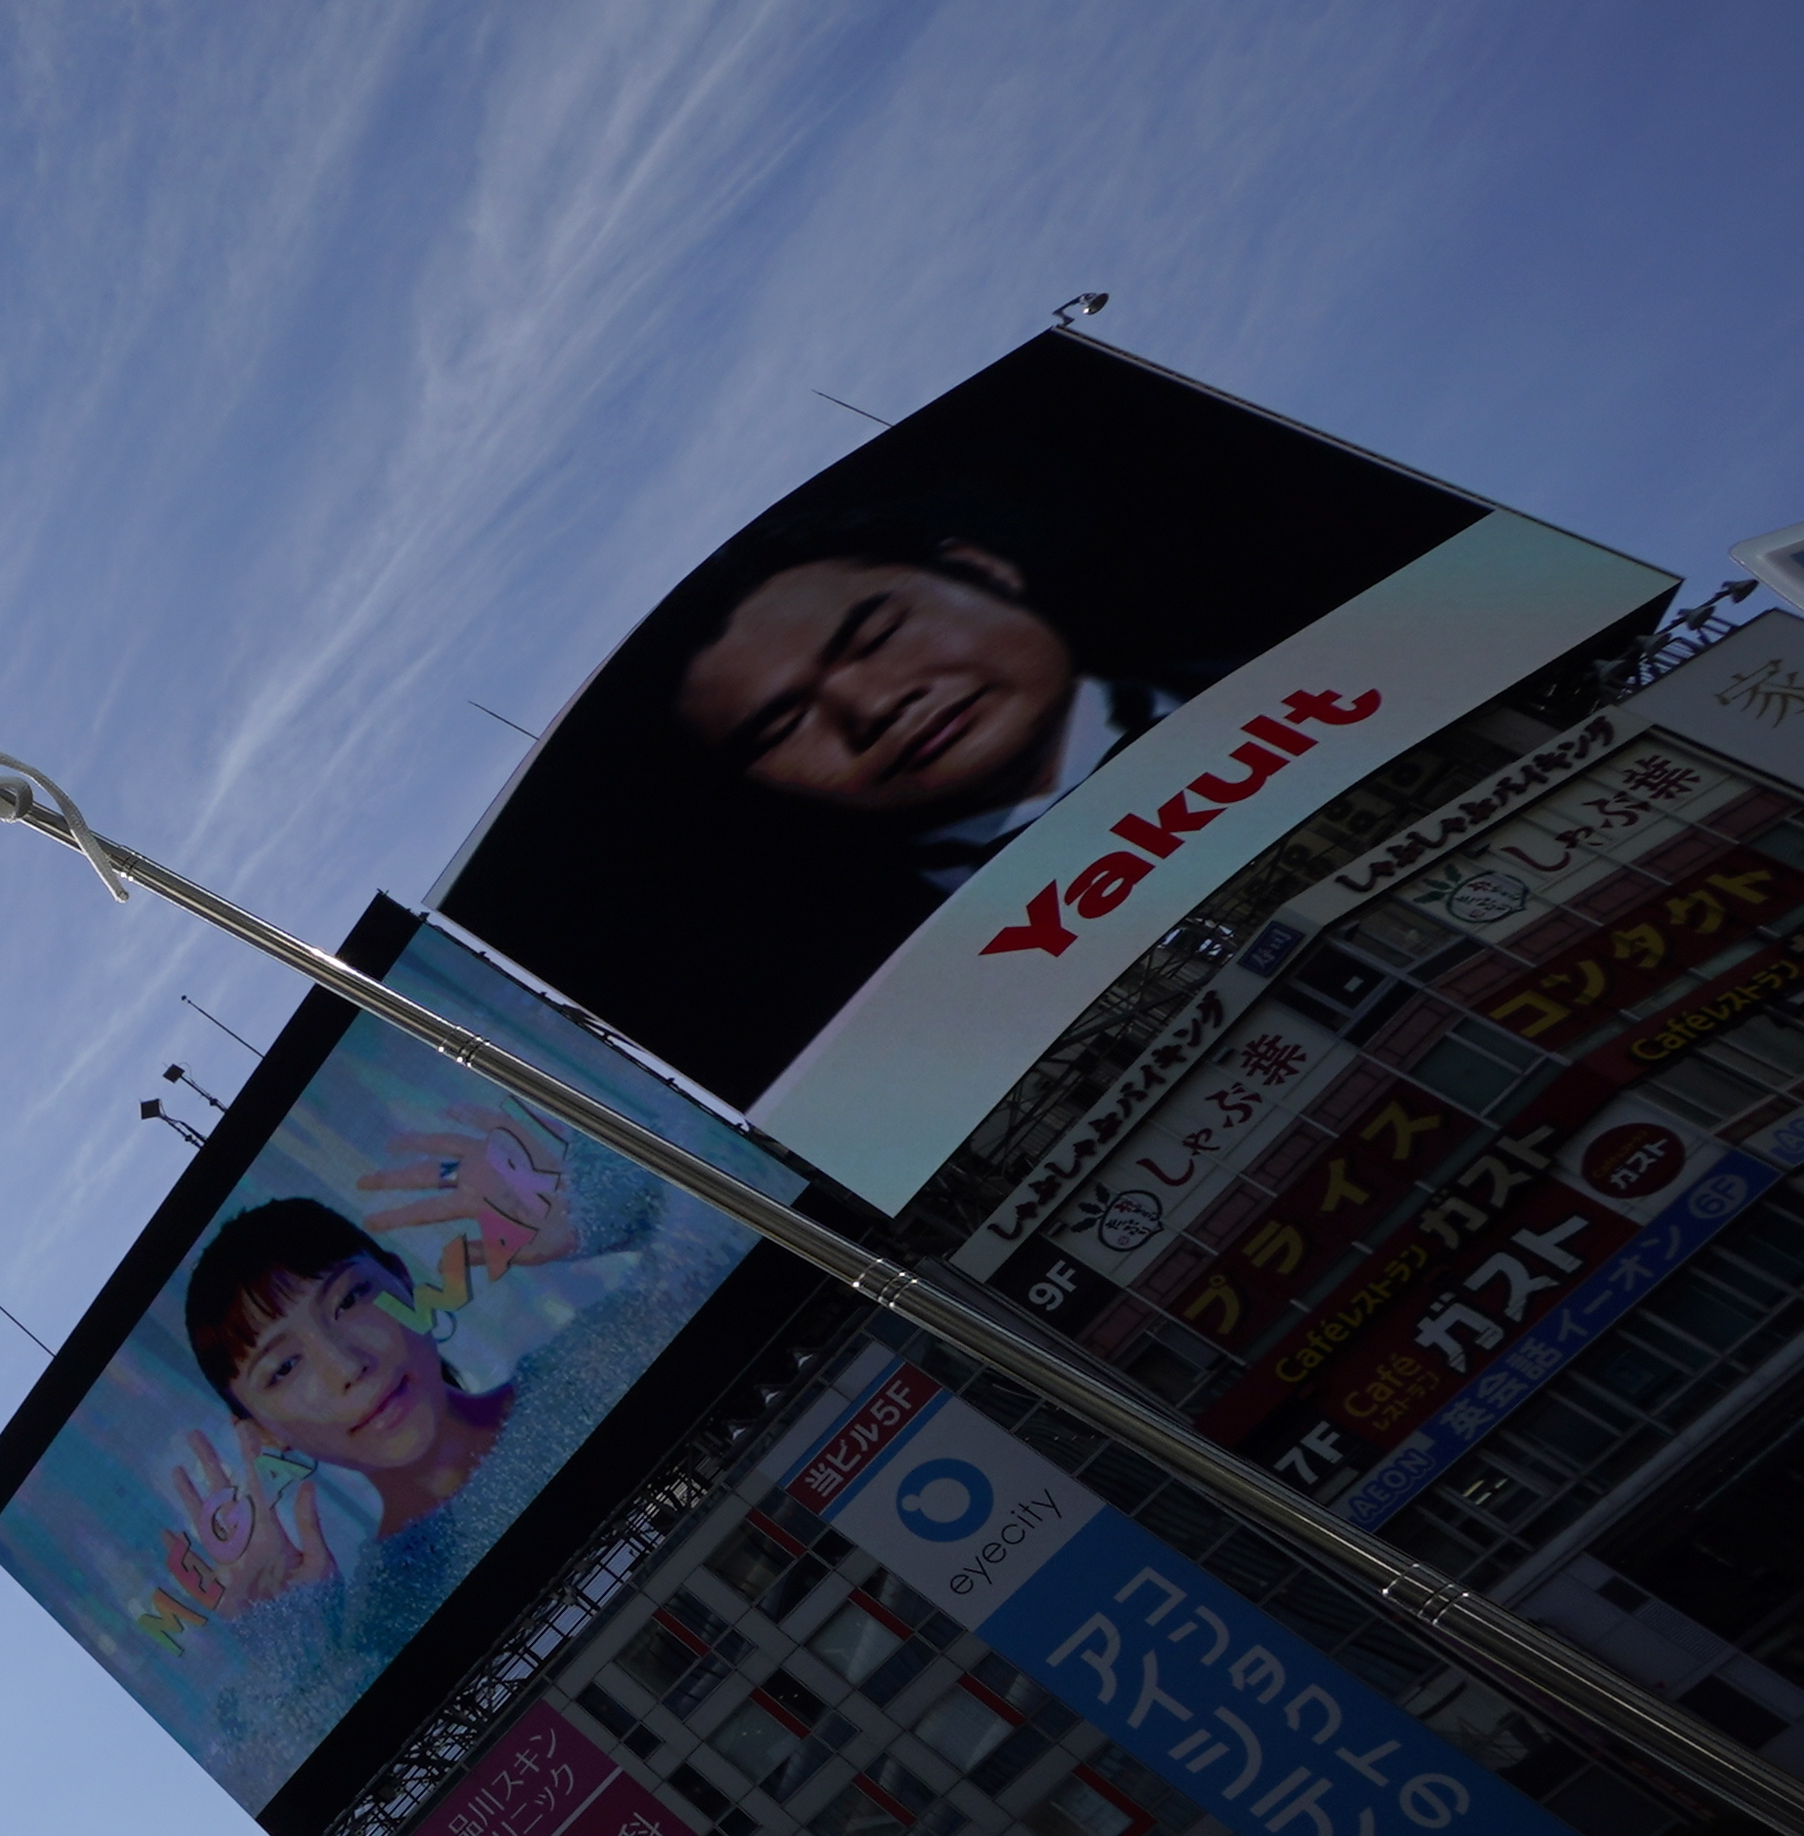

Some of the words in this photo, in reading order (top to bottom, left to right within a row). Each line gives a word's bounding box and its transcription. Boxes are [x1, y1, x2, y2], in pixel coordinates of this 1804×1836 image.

[979, 686, 1381, 957] Yakult
[1501, 755, 1701, 871] しゃぶ葉
[1489, 869, 1775, 1038] コンタクト
[1136, 1034, 1307, 1186] しゃぶ葉
[1608, 1137, 1669, 1190] ガスト
[1027, 1259, 1080, 1311] 9F
[1182, 1099, 1442, 1335] プライス
[1414, 1213, 1589, 1374] ガスト
[1439, 1223, 1682, 1441] 英会話イーオン
[1693, 1174, 1739, 1215] 6F
[137, 1451, 316, 1657] MEGA
[373, 1094, 569, 1336] WARI
[1343, 1352, 1424, 1419] Café
[1274, 1420, 1345, 1485] 7F
[1351, 1447, 1435, 1521] AEON
[949, 1486, 1065, 1596] eyecity
[1114, 1565, 1471, 1829] コンタクトの
